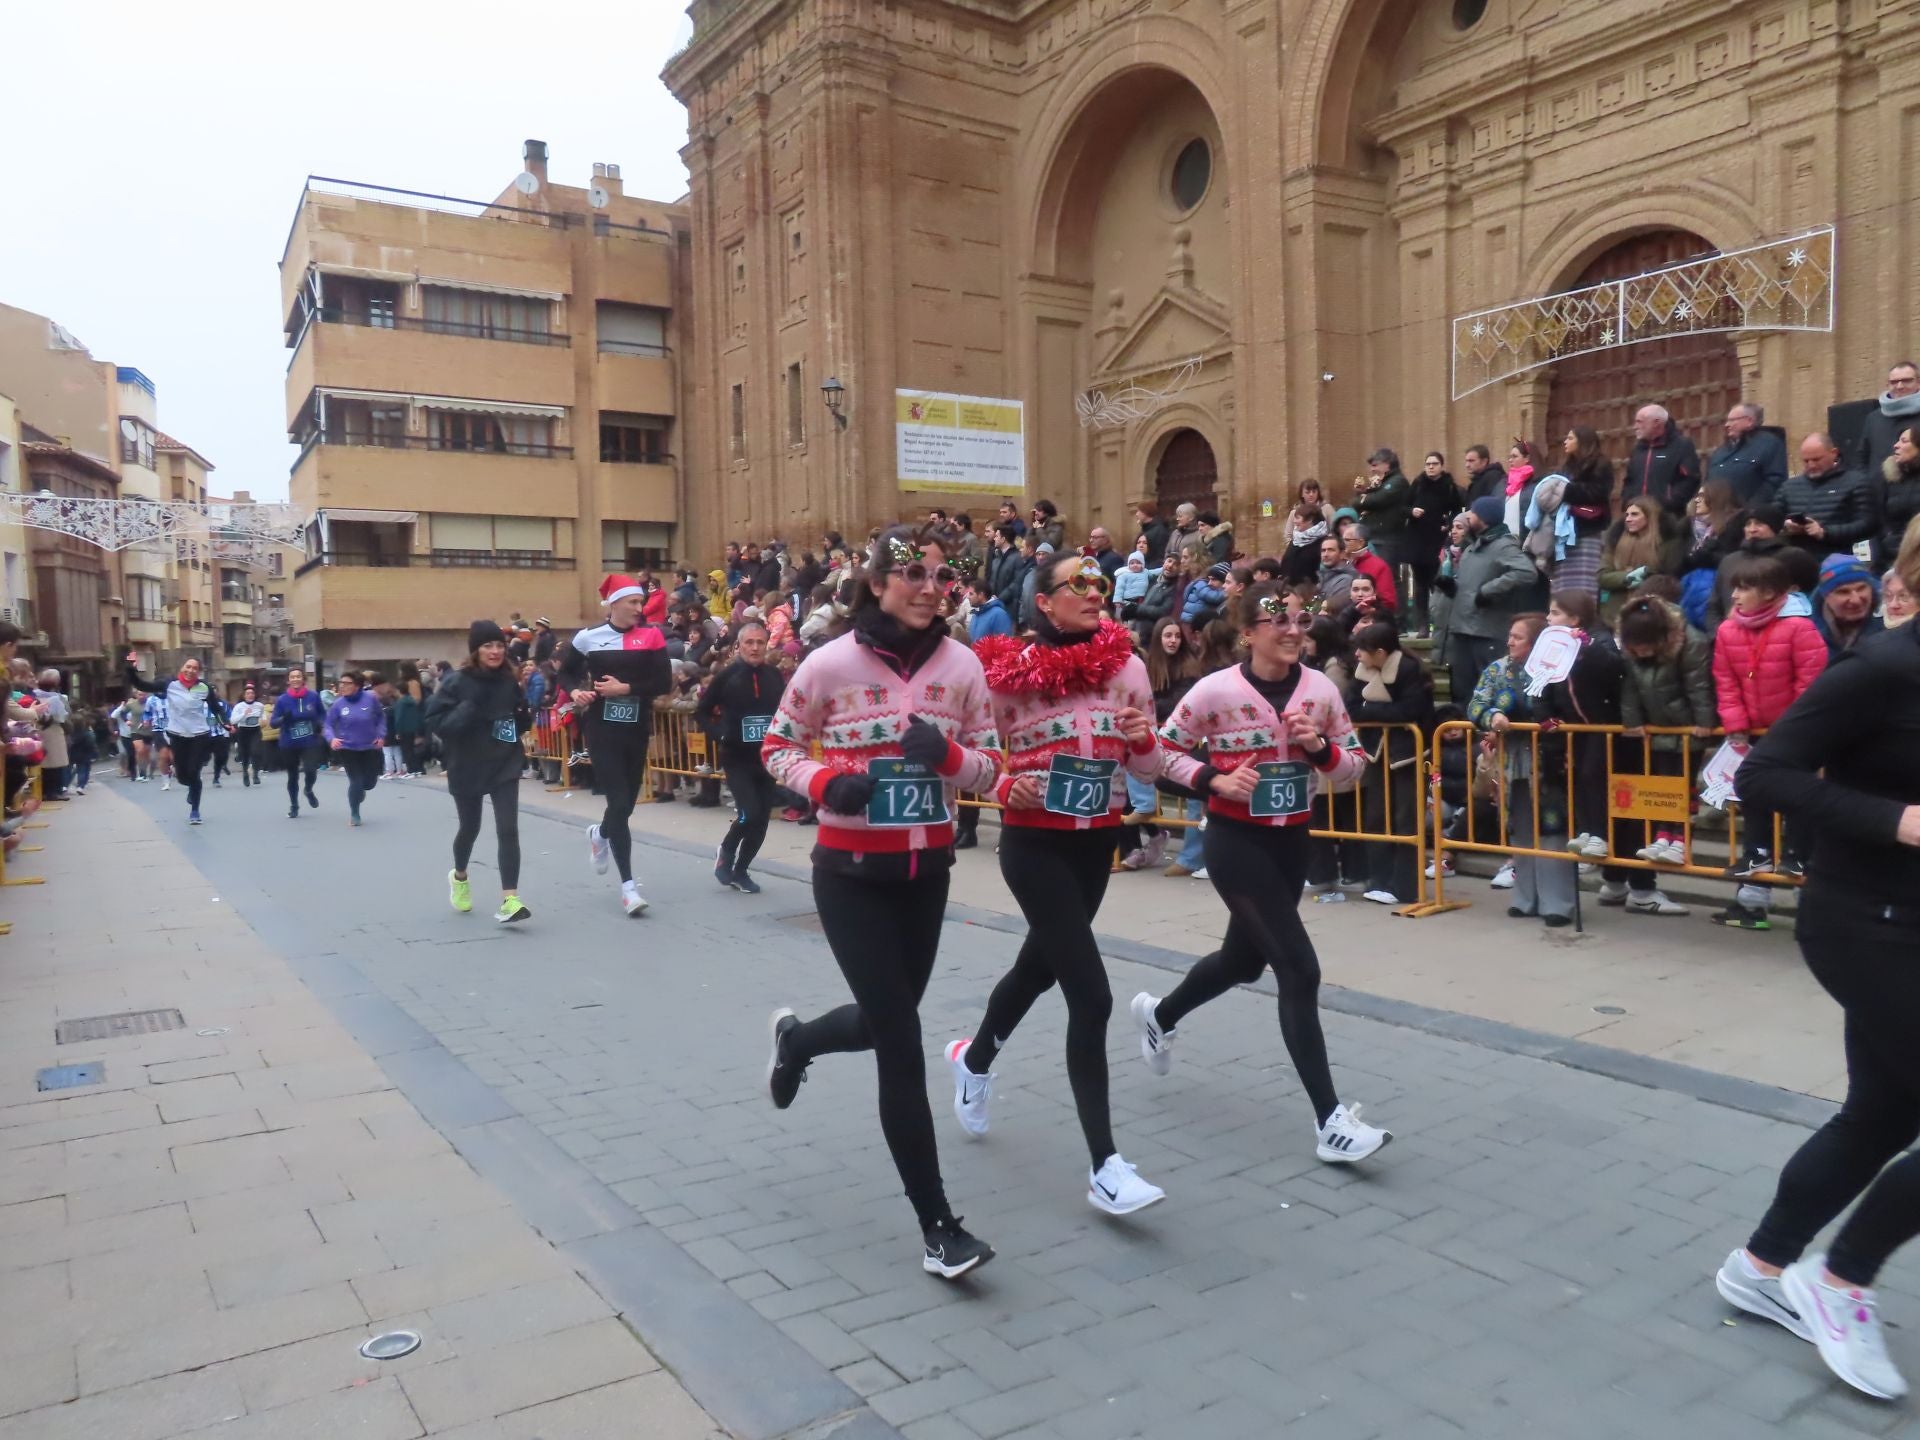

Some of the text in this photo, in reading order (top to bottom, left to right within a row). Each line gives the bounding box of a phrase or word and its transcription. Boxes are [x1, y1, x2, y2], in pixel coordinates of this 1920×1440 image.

[610, 705, 633, 719] 302
[885, 784, 935, 817] 124
[1063, 779, 1104, 811] 120
[1270, 782, 1296, 809] 59
[1638, 790, 1684, 800] AYUNTAMIENTO
[1644, 799, 1677, 808] DE ALFARO
